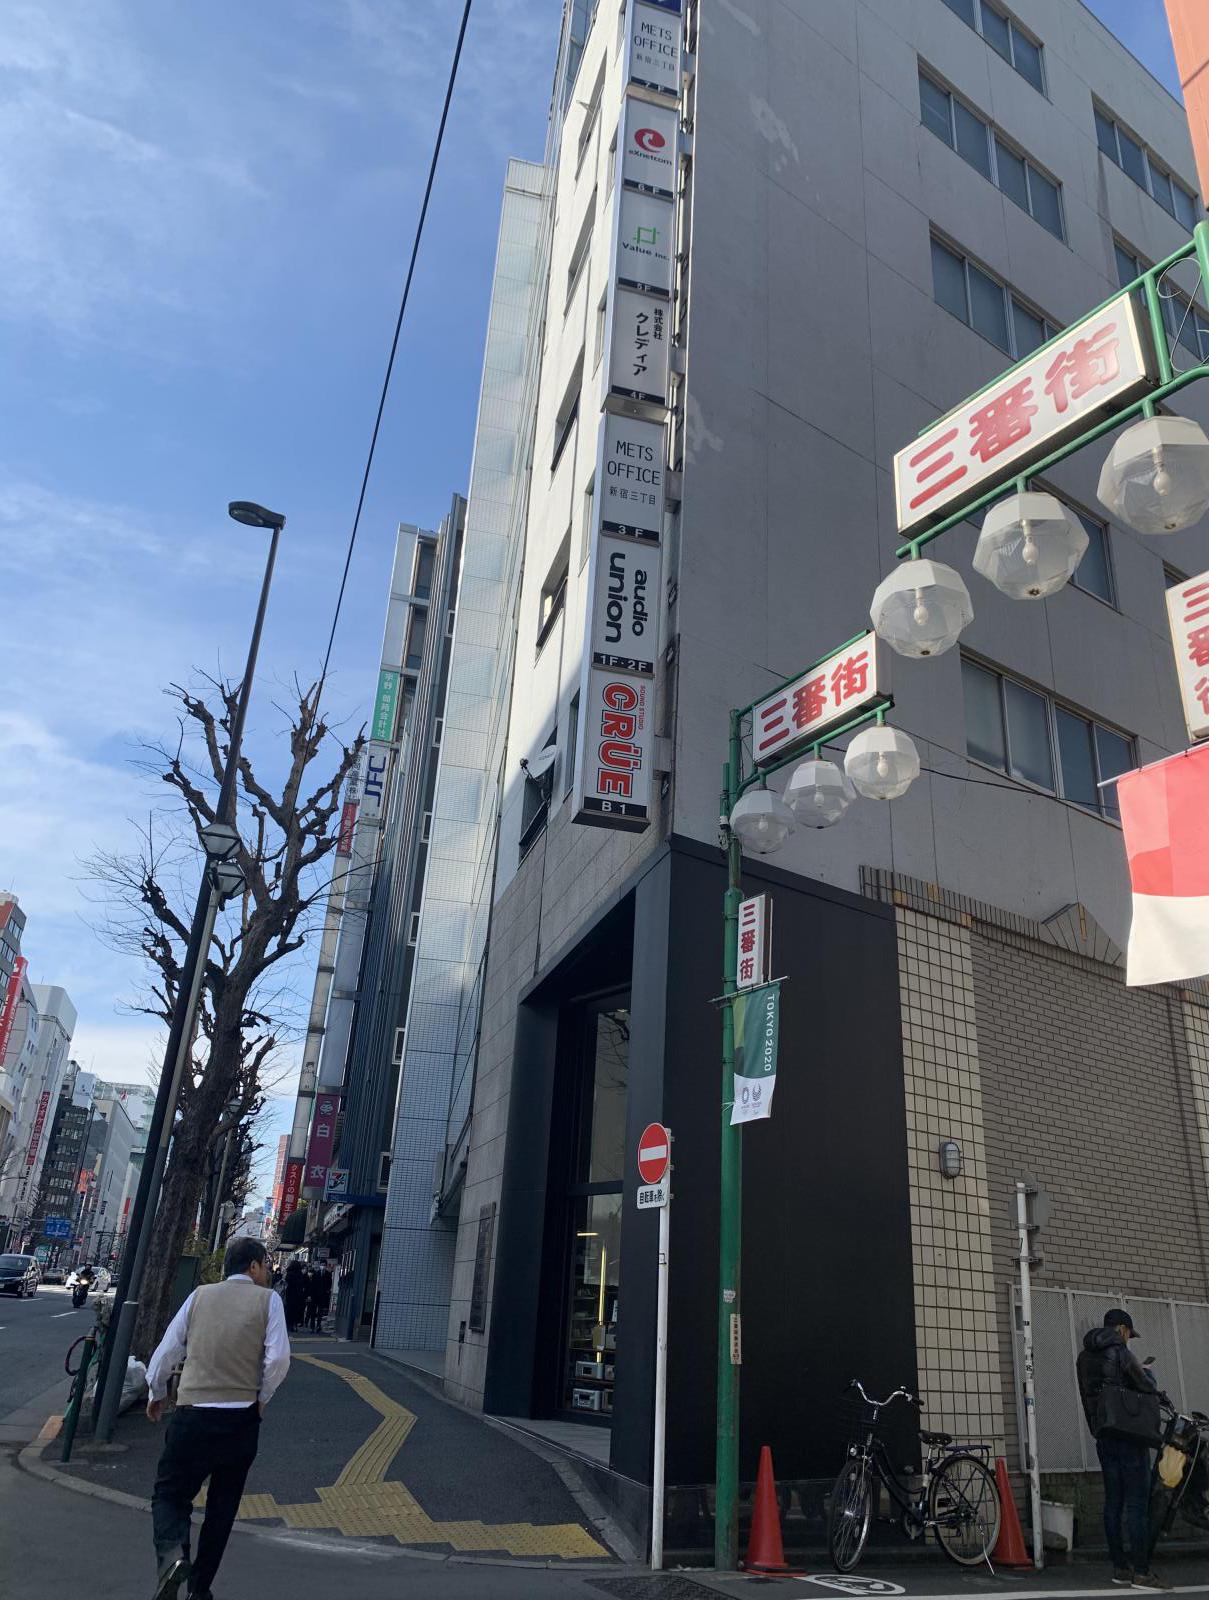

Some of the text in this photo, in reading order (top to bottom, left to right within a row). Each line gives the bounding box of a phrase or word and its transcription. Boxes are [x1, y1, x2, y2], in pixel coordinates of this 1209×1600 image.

[634, 35, 678, 57] OFFICE
[641, 22, 672, 41] METS
[628, 149, 673, 166] eXnetcom
[622, 241, 652, 256] Value
[633, 312, 649, 376] クレディア
[653, 307, 664, 341] 株式会社
[909, 322, 1120, 511] 三番街
[607, 460, 661, 486] OFFICE
[616, 440, 653, 462] METS
[609, 486, 656, 505] 新宿三丁目
[605, 552, 628, 643] union
[632, 569, 648, 636] audio
[759, 650, 869, 751] 三番街
[597, 682, 642, 798] CRÜE
[740, 903, 756, 982] 三番街
[764, 994, 775, 1072] TOKYO 2020
